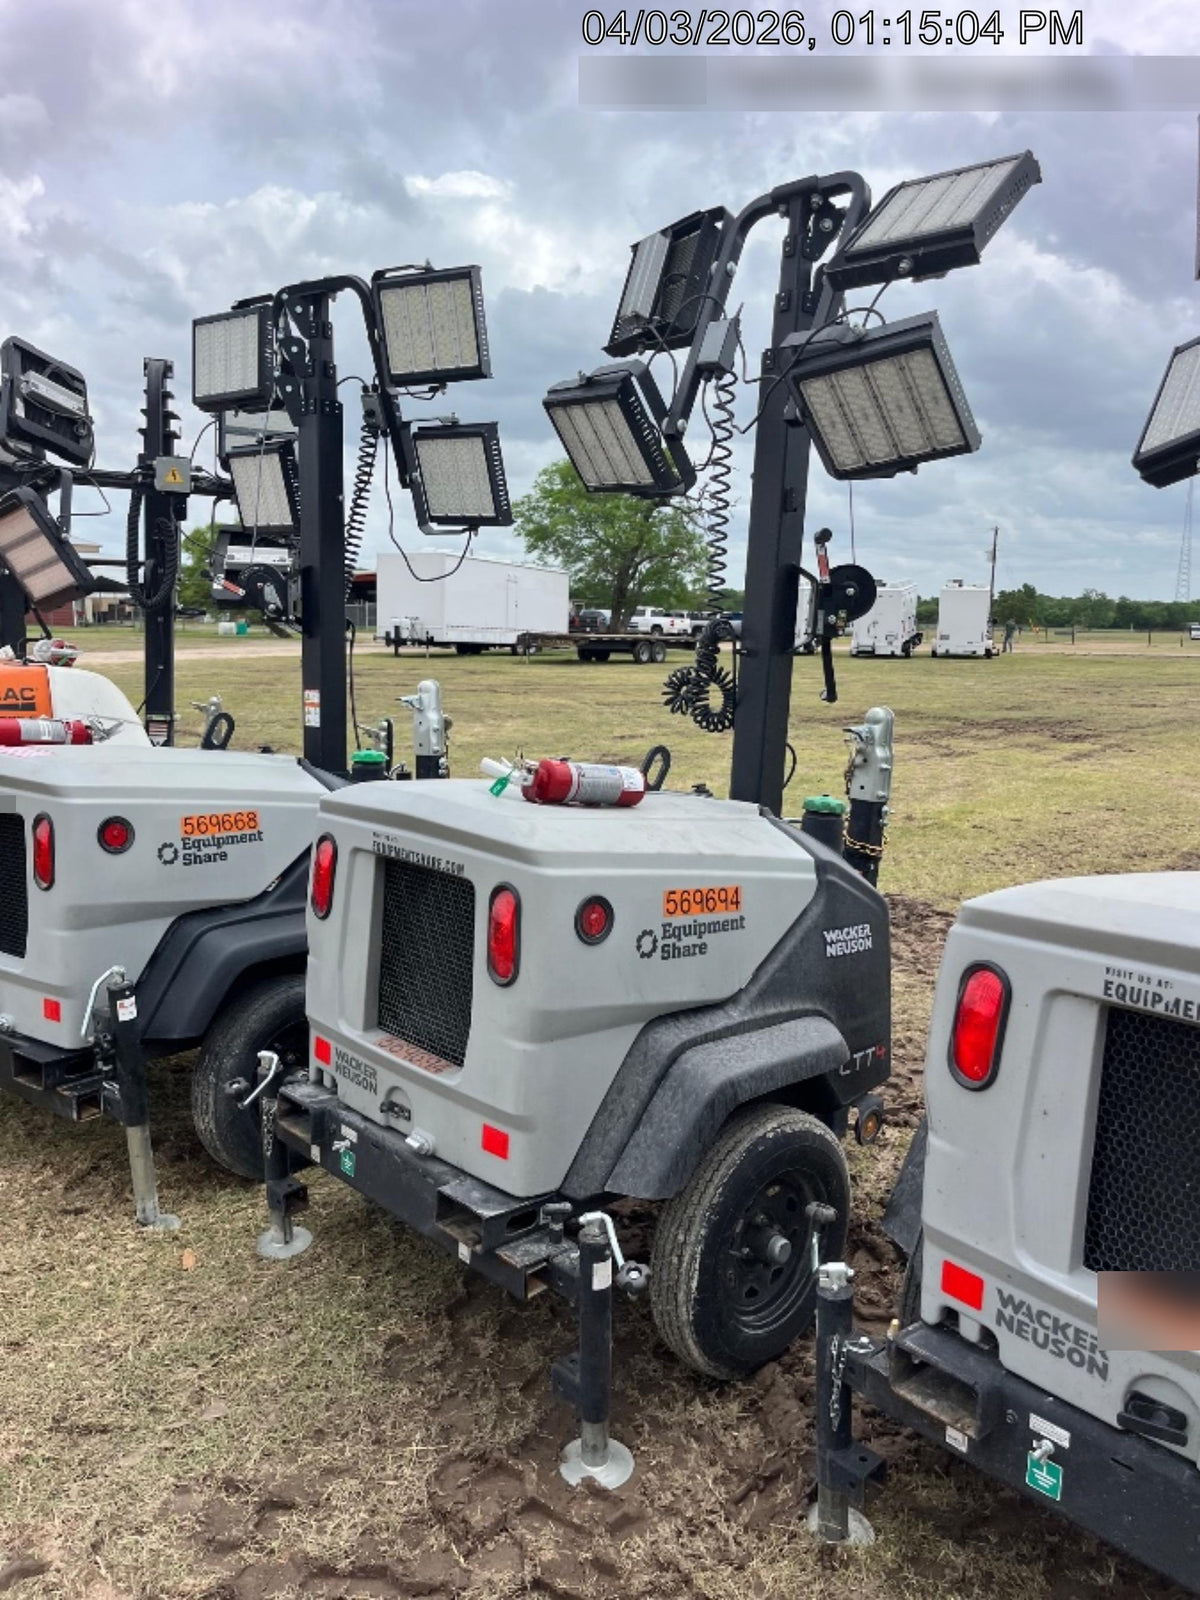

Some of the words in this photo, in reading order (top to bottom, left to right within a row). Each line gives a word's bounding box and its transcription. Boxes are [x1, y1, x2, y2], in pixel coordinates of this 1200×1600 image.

[0, 687, 36, 701] AC
[183, 811, 258, 835] 569668
[181, 830, 263, 852] Equipment
[182, 850, 228, 866] Share
[665, 886, 741, 915] 569694
[661, 915, 745, 942] Equipment
[823, 923, 872, 943] WACKER
[661, 941, 708, 961] Share
[826, 936, 872, 957] NEUSON
[1105, 966, 1133, 981] VISIT
[1138, 974, 1151, 985] US
[335, 1046, 378, 1080] WACKER
[335, 1062, 378, 1096] NEUSON
[996, 1308, 1109, 1382] NEUSON
